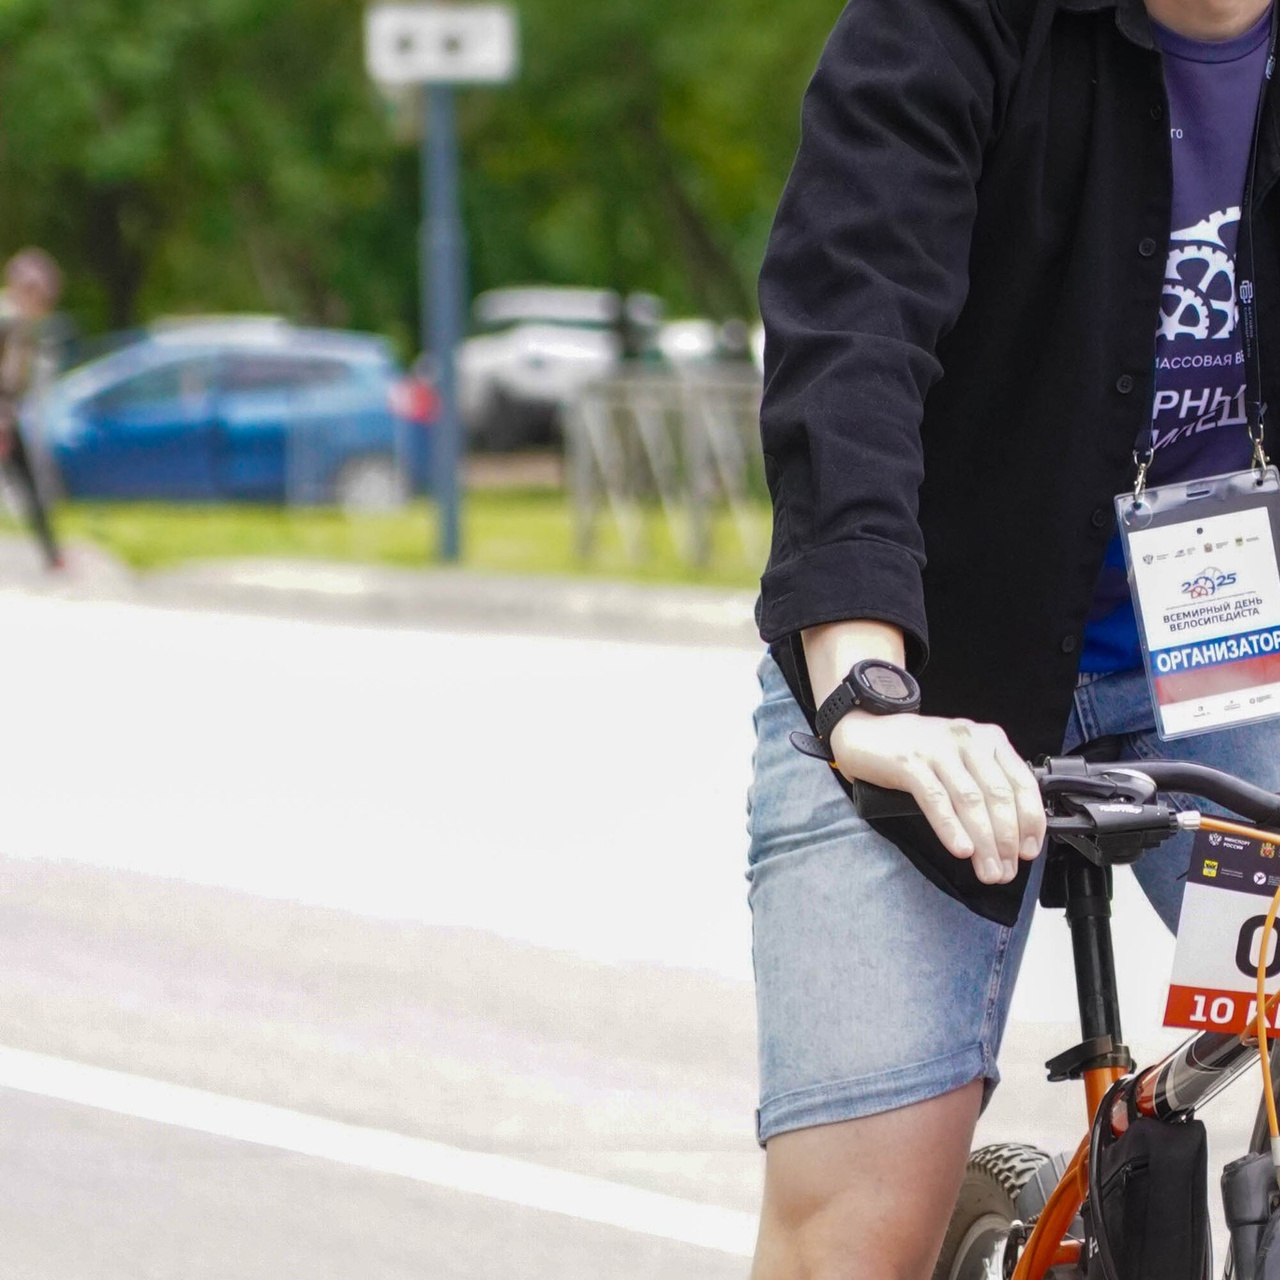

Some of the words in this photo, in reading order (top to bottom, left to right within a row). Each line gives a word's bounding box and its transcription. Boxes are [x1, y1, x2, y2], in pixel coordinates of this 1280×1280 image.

[1163, 602, 1231, 624] ВСЕМИРНЫЙ
[1234, 596, 1263, 610] ДЕНЬ
[1169, 607, 1260, 632] ВЕЛОСИПЕДИСТА
[1189, 994, 1235, 1024] 10
